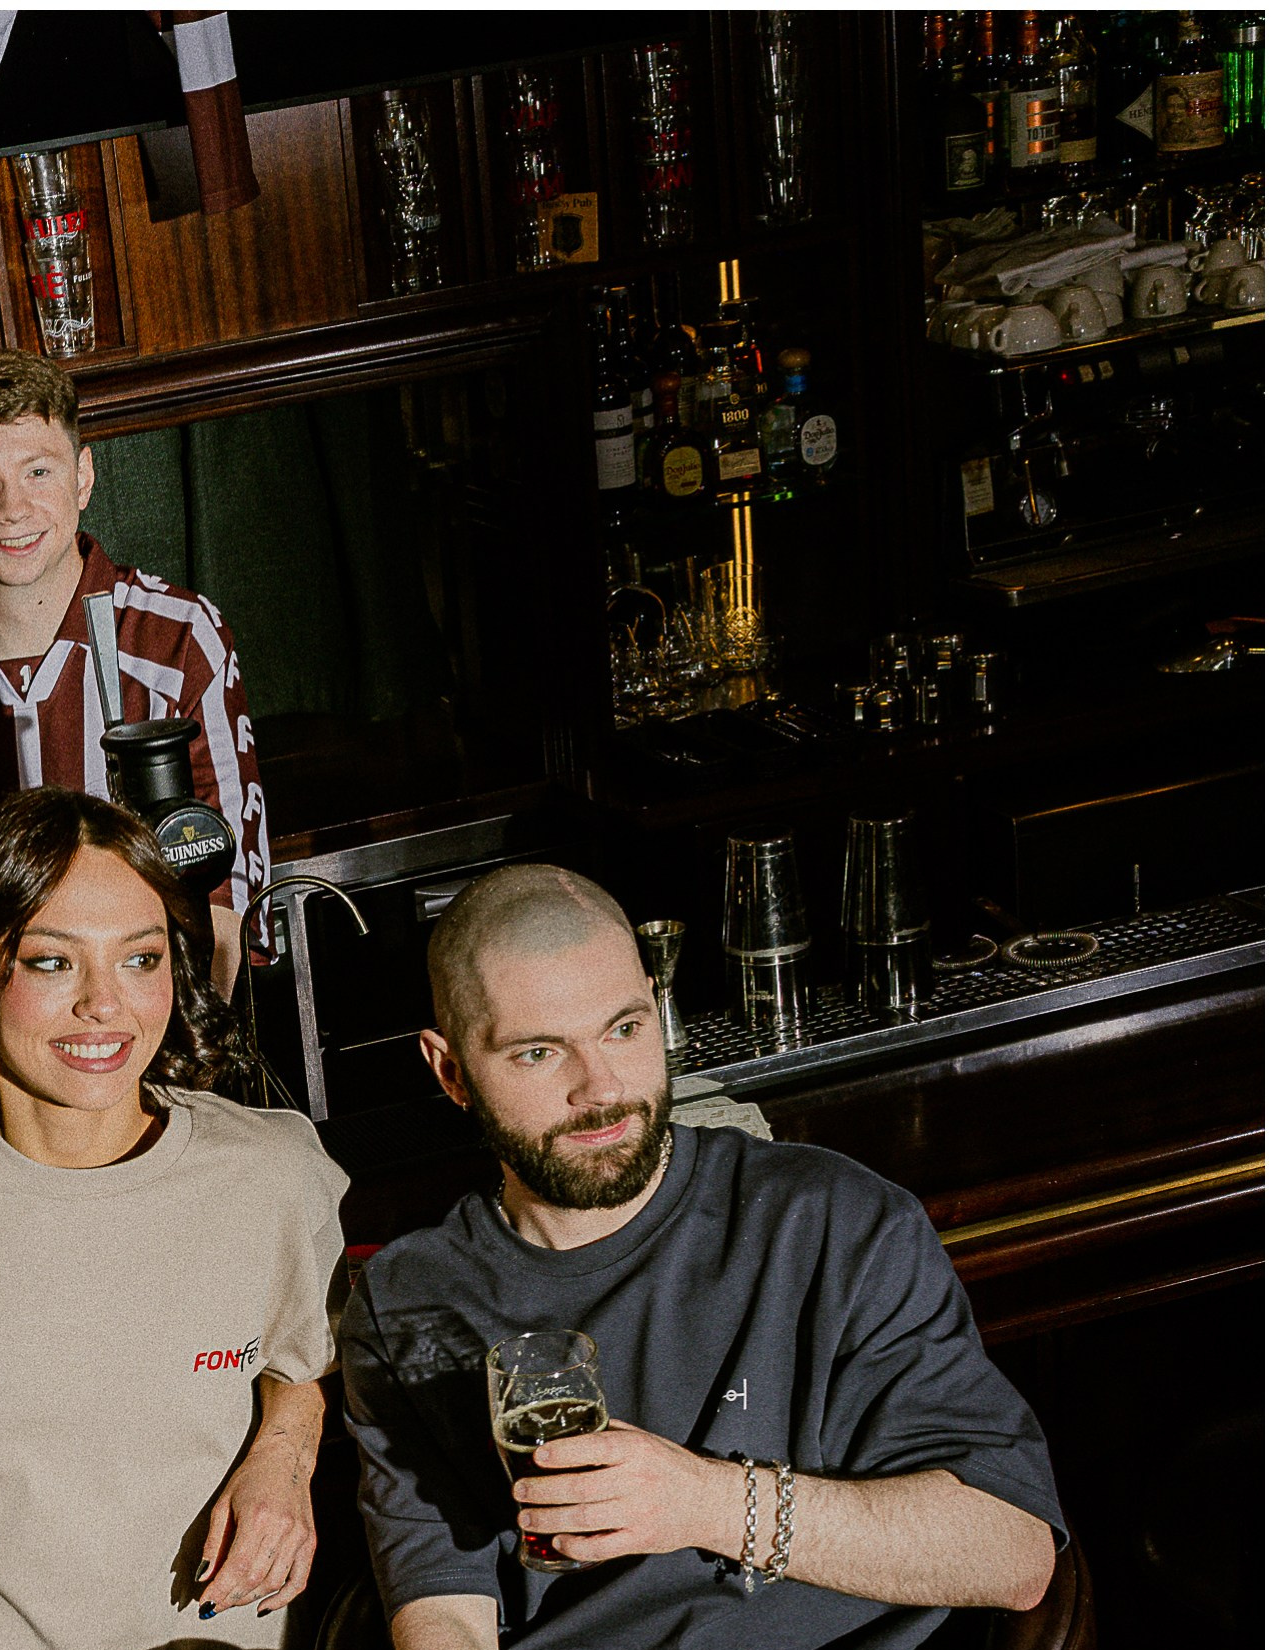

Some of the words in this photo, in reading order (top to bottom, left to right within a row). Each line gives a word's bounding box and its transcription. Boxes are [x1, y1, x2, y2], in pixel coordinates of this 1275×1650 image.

[721, 408, 749, 424] 1800
[225, 650, 241, 688] F
[237, 714, 254, 753] F
[243, 783, 262, 821] F
[161, 837, 225, 862] GUINNESS
[179, 856, 208, 866] DRAUGHT
[248, 850, 264, 887] F
